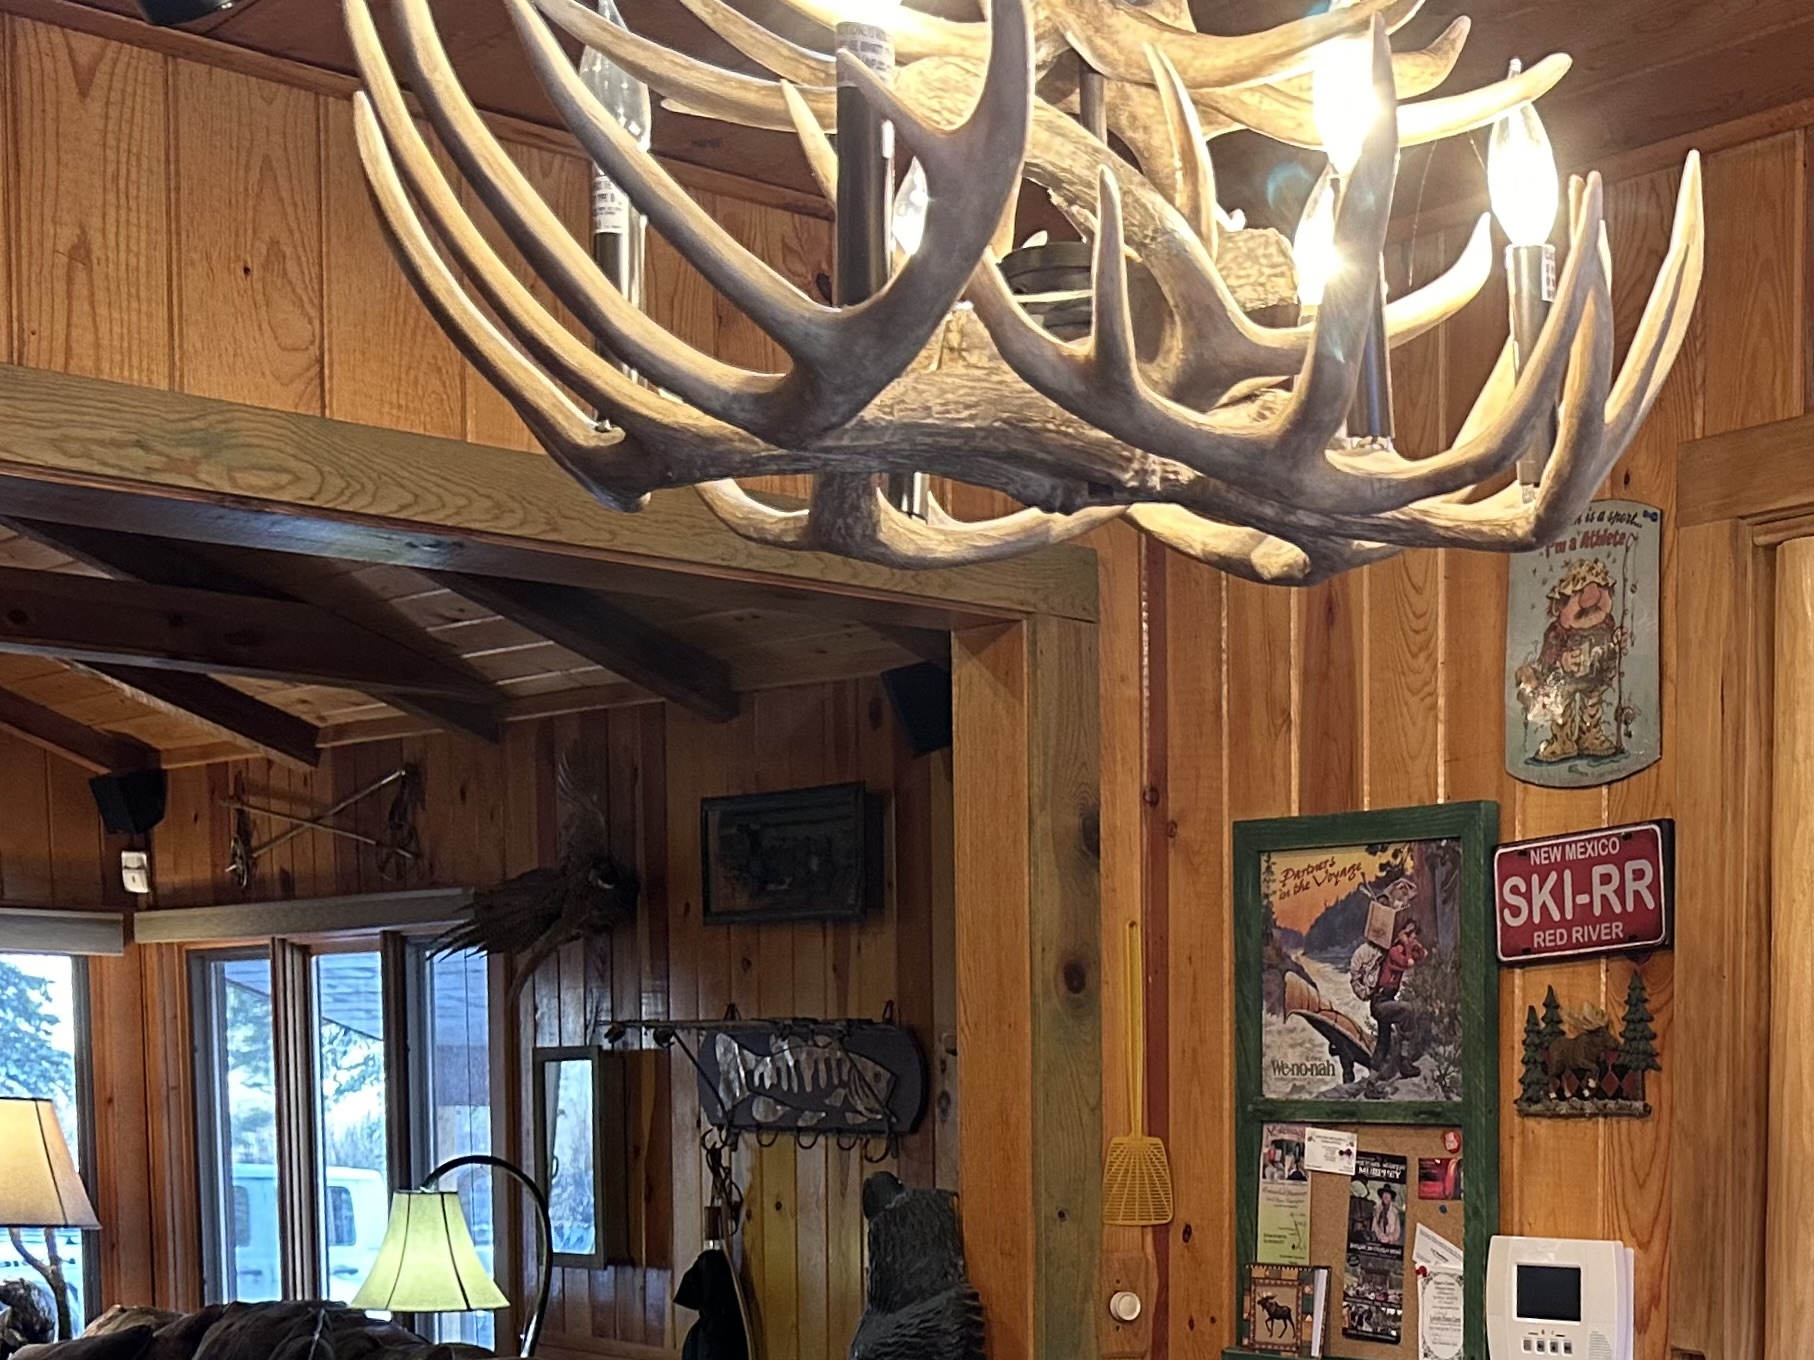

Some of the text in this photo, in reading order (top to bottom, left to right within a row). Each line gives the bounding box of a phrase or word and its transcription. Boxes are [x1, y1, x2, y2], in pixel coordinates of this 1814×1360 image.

[1580, 528, 1626, 549] Athlete
[1530, 837, 1620, 866] NEW MEXICO
[1279, 862, 1362, 901] in the Voyage
[1280, 856, 1336, 887] Partners
[1502, 859, 1656, 928] SKI-RR
[1533, 921, 1624, 948] RED RIVER
